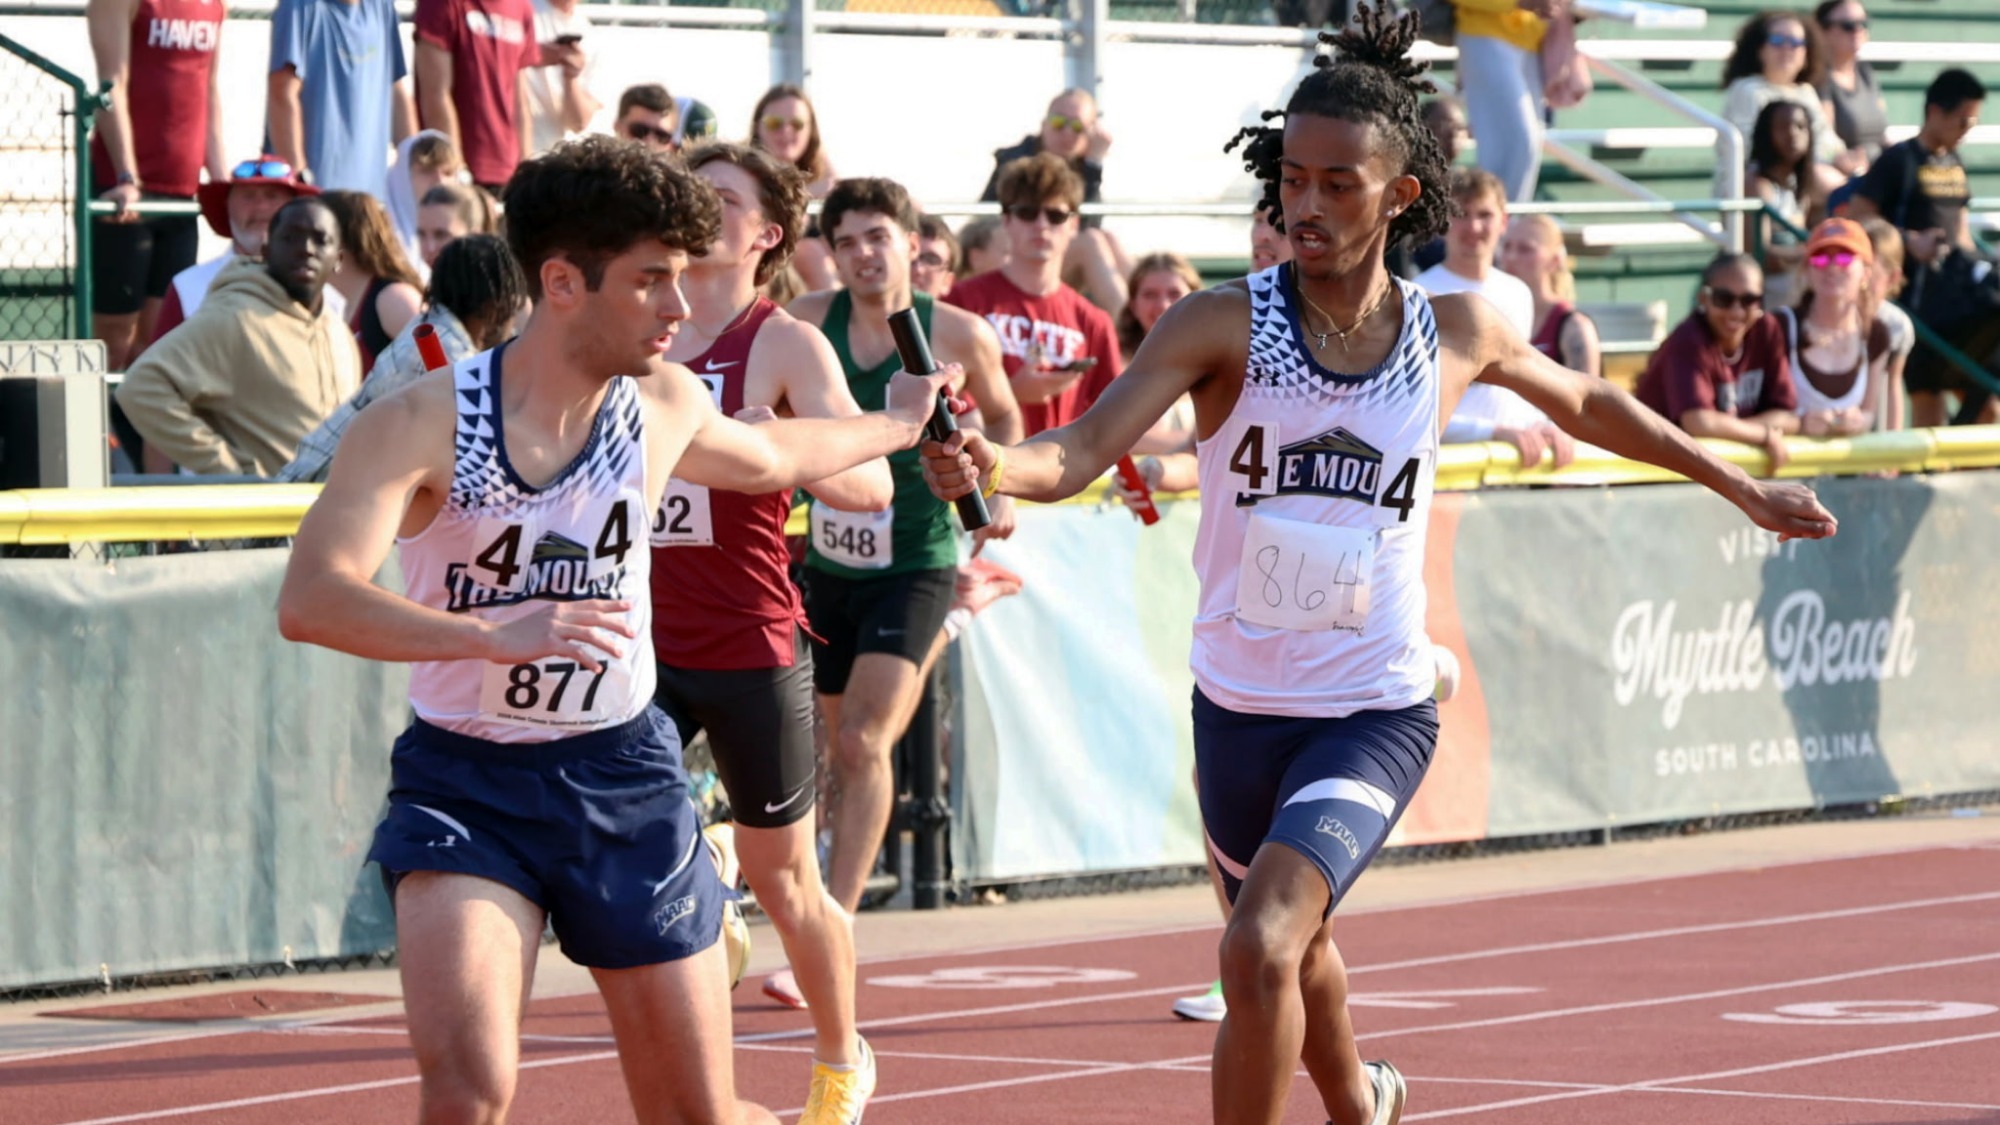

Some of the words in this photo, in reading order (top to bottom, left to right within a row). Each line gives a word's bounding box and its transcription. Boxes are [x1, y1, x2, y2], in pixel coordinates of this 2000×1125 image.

[147, 18, 219, 51] HAVEN
[1229, 425, 1269, 489] 4
[1311, 452, 1381, 495] MOU
[1380, 457, 1421, 522] 4
[475, 524, 524, 587] 4
[595, 499, 633, 566] 4
[822, 520, 877, 558] 548
[1256, 545, 1362, 614] 864
[505, 659, 609, 713] 877
[1612, 598, 1767, 730] Myrtle
[1770, 588, 1918, 692] Beach
[1655, 743, 1738, 776] SOUTH
[1749, 731, 1878, 769] CAROLINA
